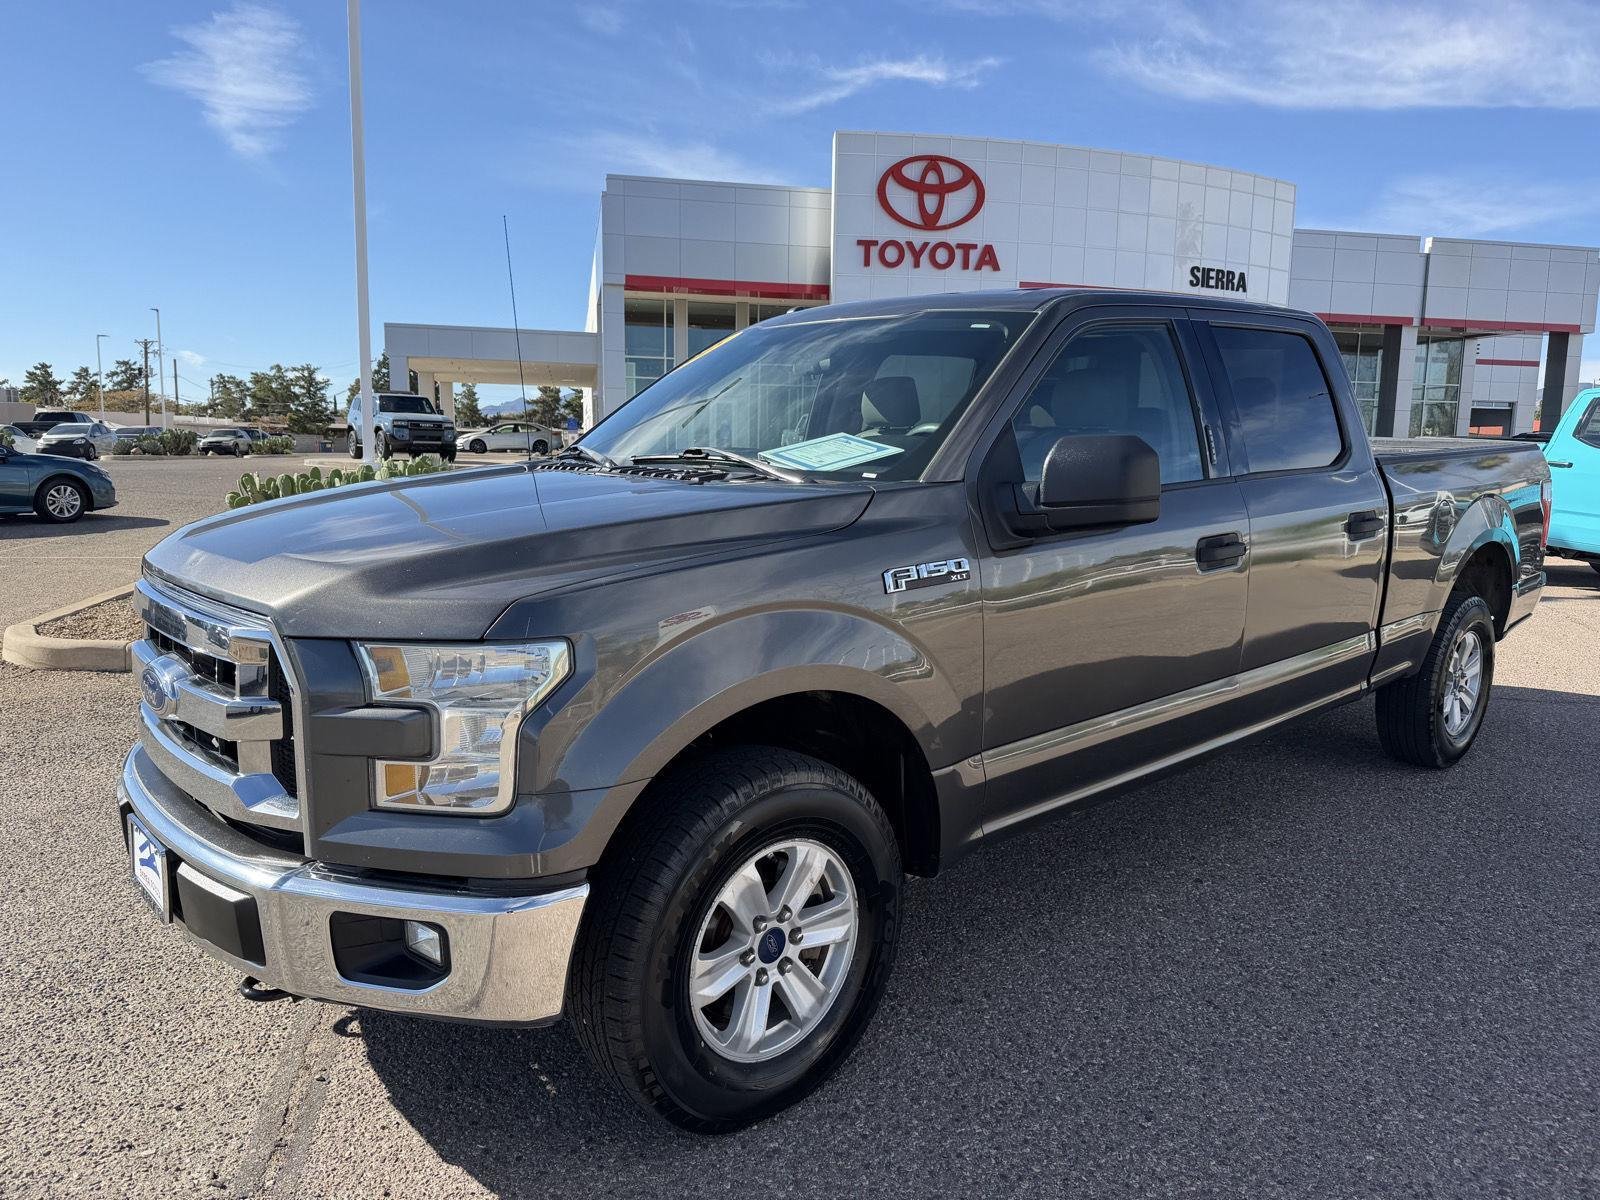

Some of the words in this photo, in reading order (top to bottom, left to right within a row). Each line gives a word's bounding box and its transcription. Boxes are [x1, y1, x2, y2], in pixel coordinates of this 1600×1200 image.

[857, 240, 1001, 271] TOYOTA
[1189, 266, 1247, 293] SIERRA
[951, 573, 968, 581] XLT
